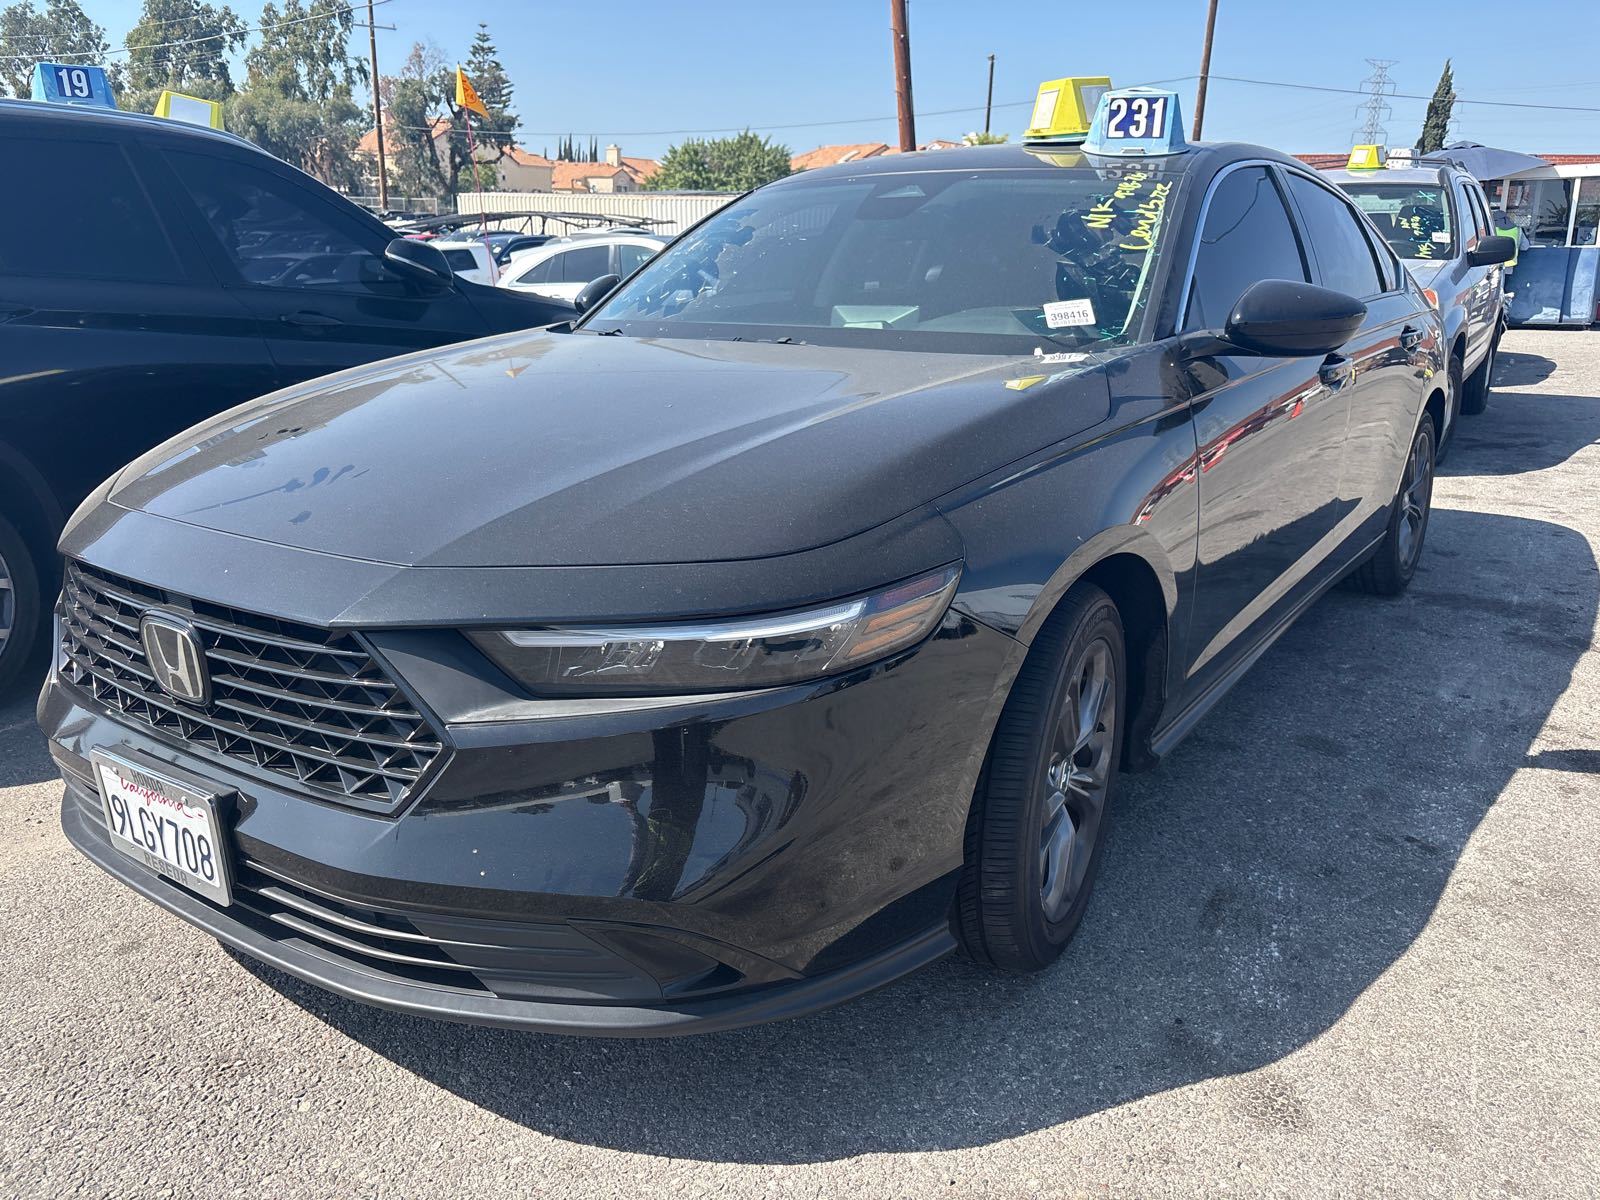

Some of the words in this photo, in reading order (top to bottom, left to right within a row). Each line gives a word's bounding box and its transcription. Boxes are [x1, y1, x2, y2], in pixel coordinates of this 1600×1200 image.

[58, 68, 89, 98] 19
[1107, 98, 1165, 139] 231
[1050, 309, 1089, 322] 398416
[111, 794, 214, 881] 9LGY708
[143, 852, 189, 886] RESEDA
